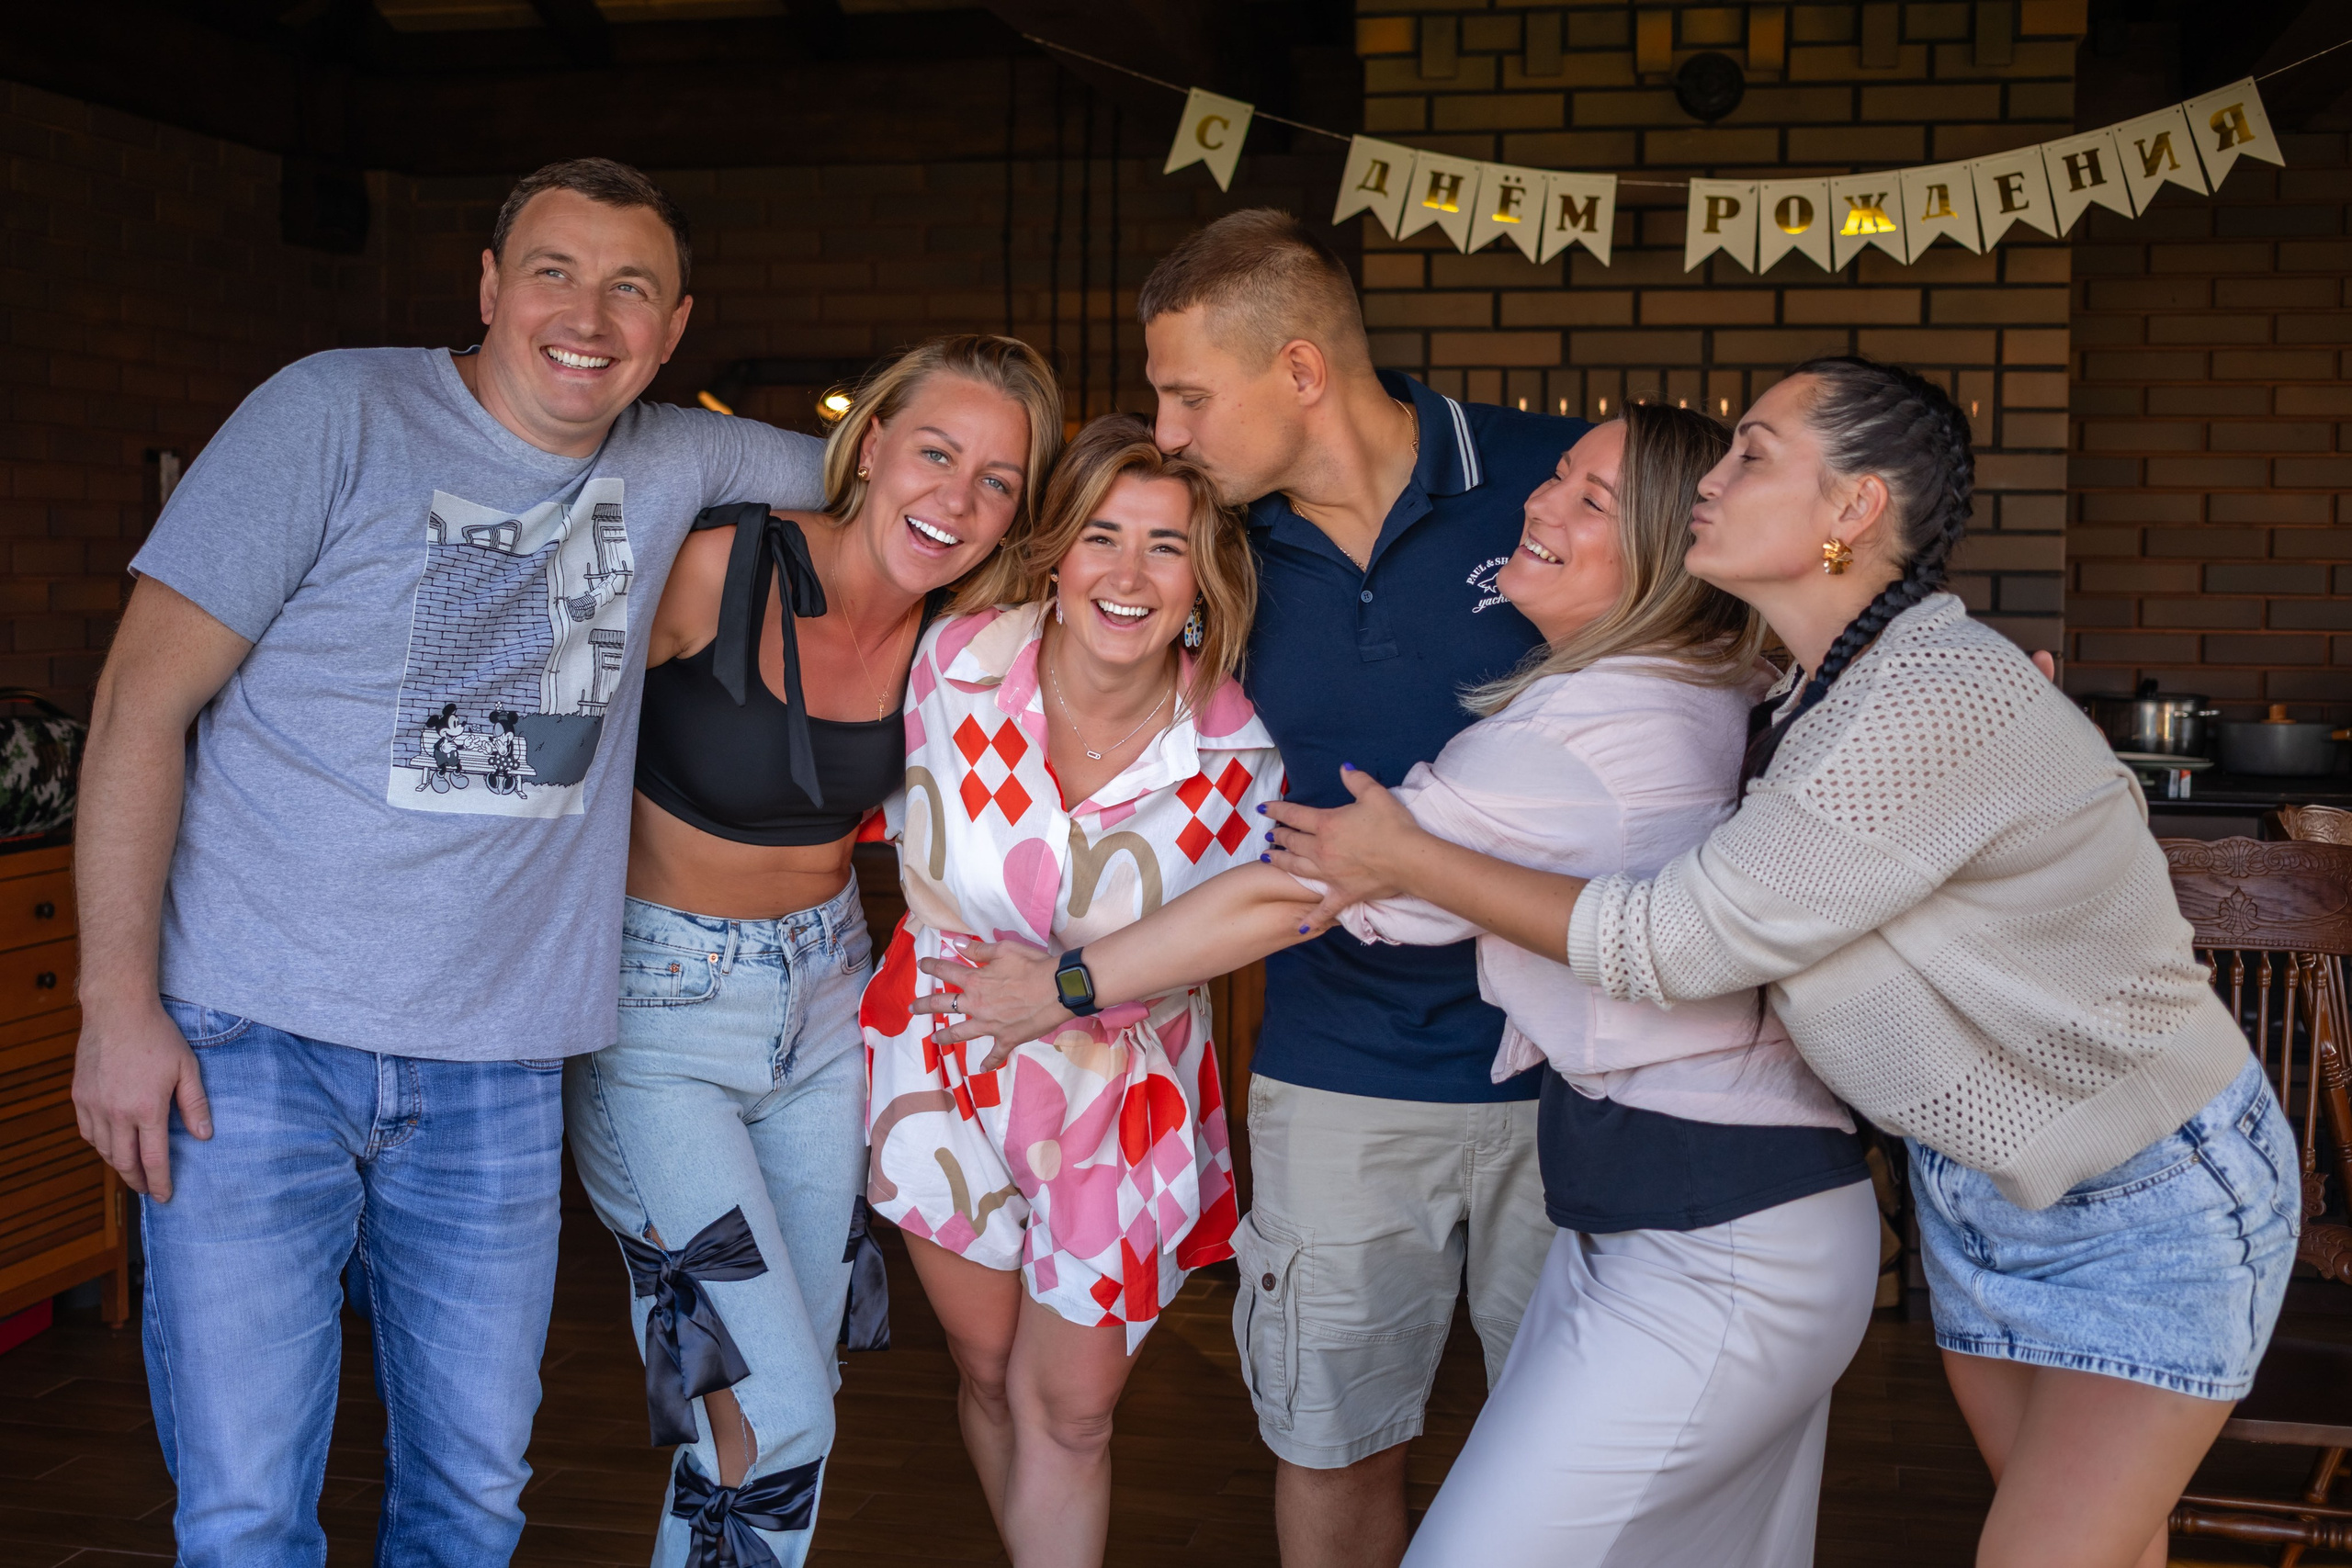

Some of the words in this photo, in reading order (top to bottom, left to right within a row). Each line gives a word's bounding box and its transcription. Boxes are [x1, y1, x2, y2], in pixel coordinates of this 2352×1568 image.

[1196, 115, 1229, 151] С
[1357, 159, 1600, 233] ДНЁМ
[1702, 102, 2254, 236] РОЖДЕНИЯ
[1466, 564, 1487, 585] PAUL
[1487, 559, 1495, 569] &
